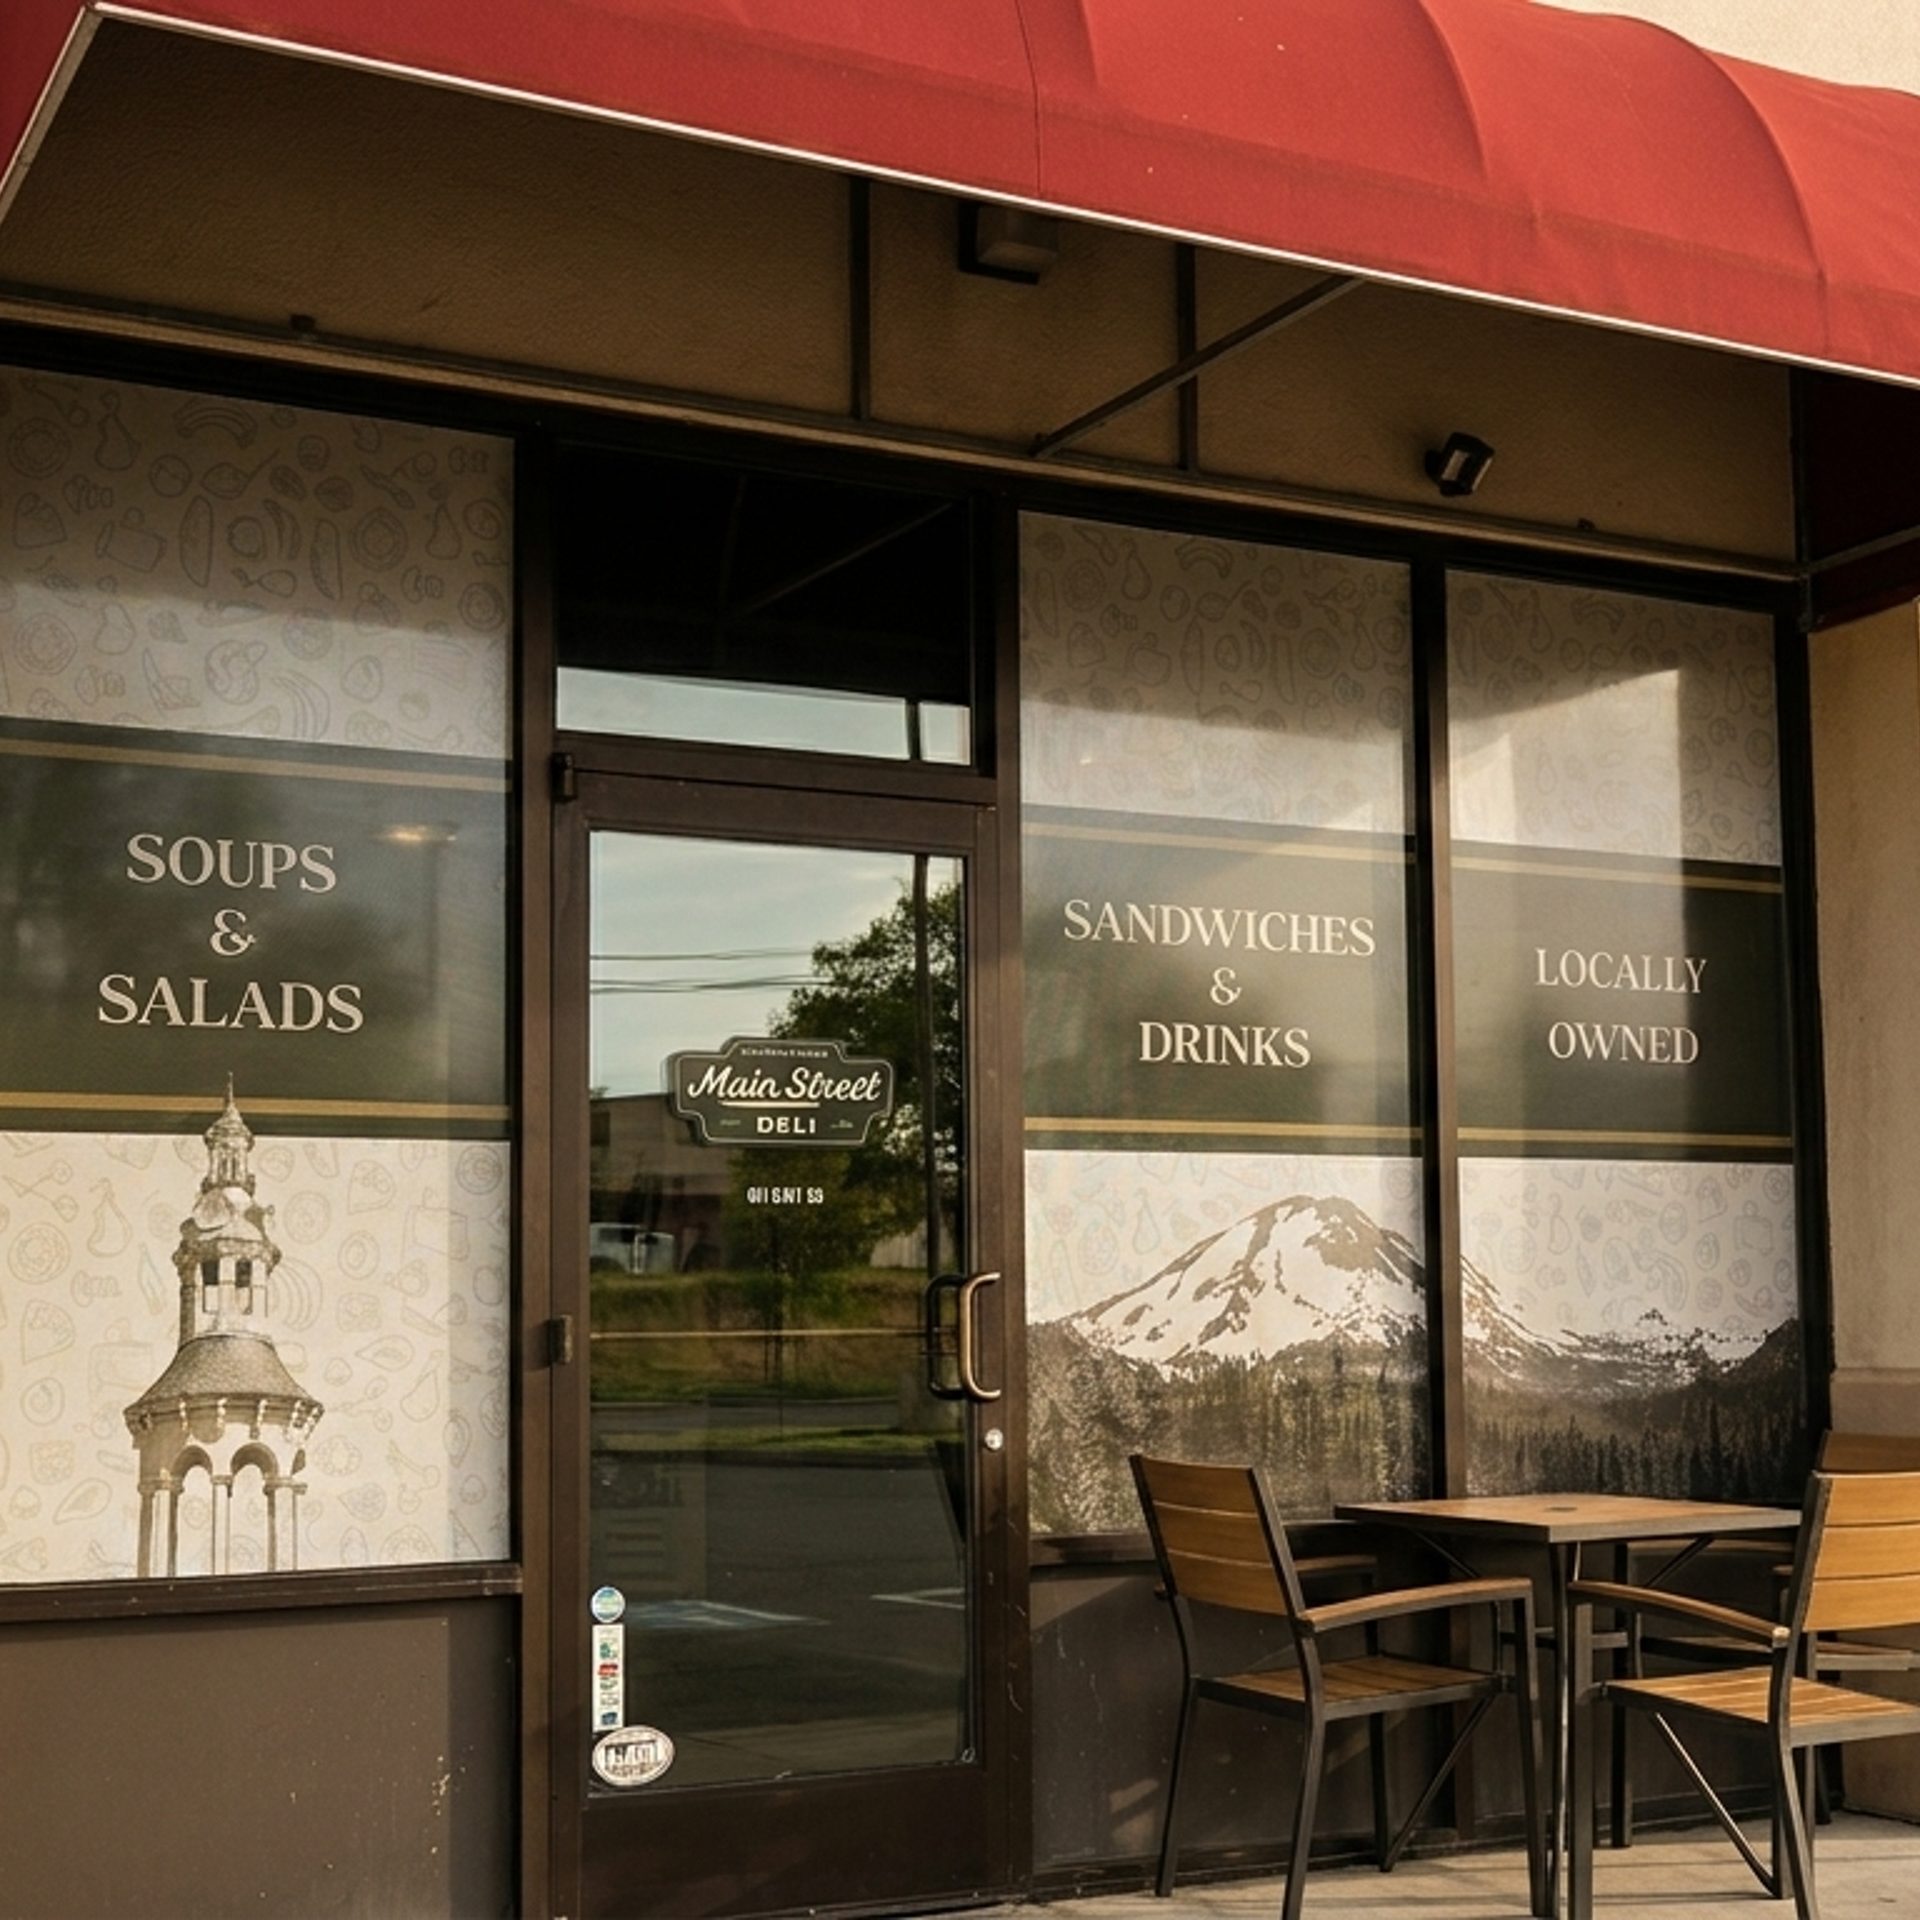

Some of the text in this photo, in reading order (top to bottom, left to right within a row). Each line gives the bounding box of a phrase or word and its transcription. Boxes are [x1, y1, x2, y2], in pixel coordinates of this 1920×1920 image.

[126, 833, 337, 893] SOUPS
[209, 908, 256, 956] &
[1064, 899, 1376, 957] SANDWICHES
[1210, 967, 1242, 1005] &
[1535, 948, 1707, 993] LOCALLY
[99, 973, 364, 1033] SALADS
[1139, 1021, 1311, 1068] DRINKS
[1549, 1021, 1699, 1064] OWNED
[688, 1064, 881, 1101] Main Street
[757, 1117, 816, 1133] DELI
